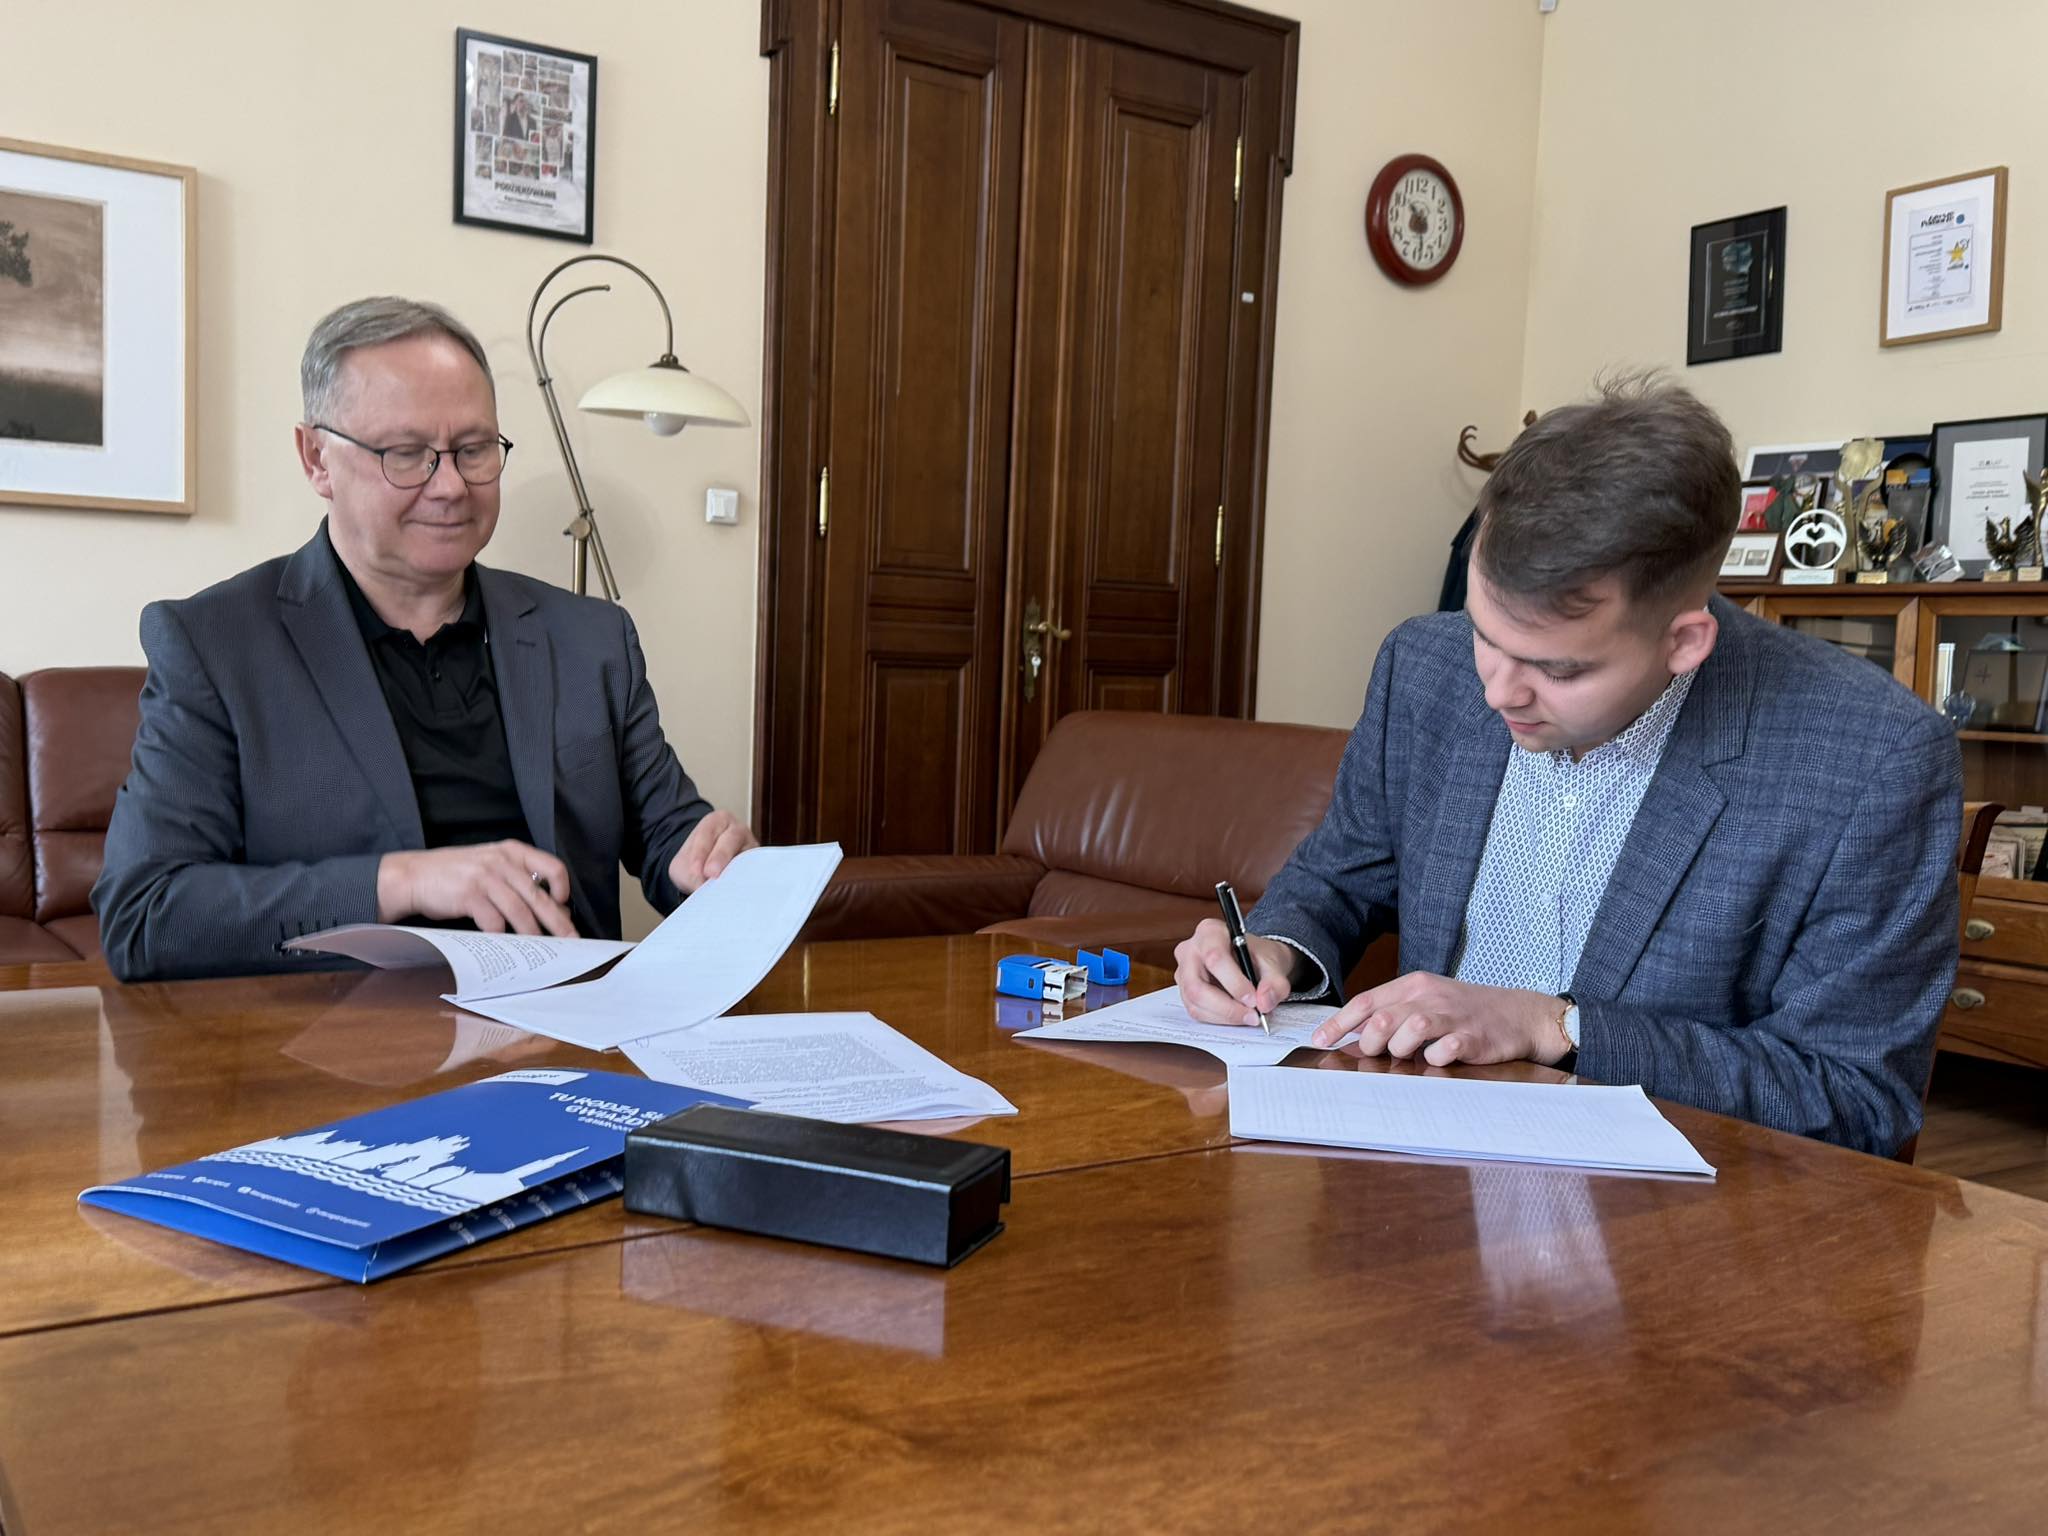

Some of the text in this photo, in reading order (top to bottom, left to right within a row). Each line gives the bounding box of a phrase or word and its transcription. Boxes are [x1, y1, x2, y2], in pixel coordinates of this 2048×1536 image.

[1416, 178, 1429, 193] 12
[1437, 199, 1446, 214] 2
[1438, 217, 1448, 232] 3
[1402, 240, 1410, 257] 7
[549, 1092, 577, 1102] TU
